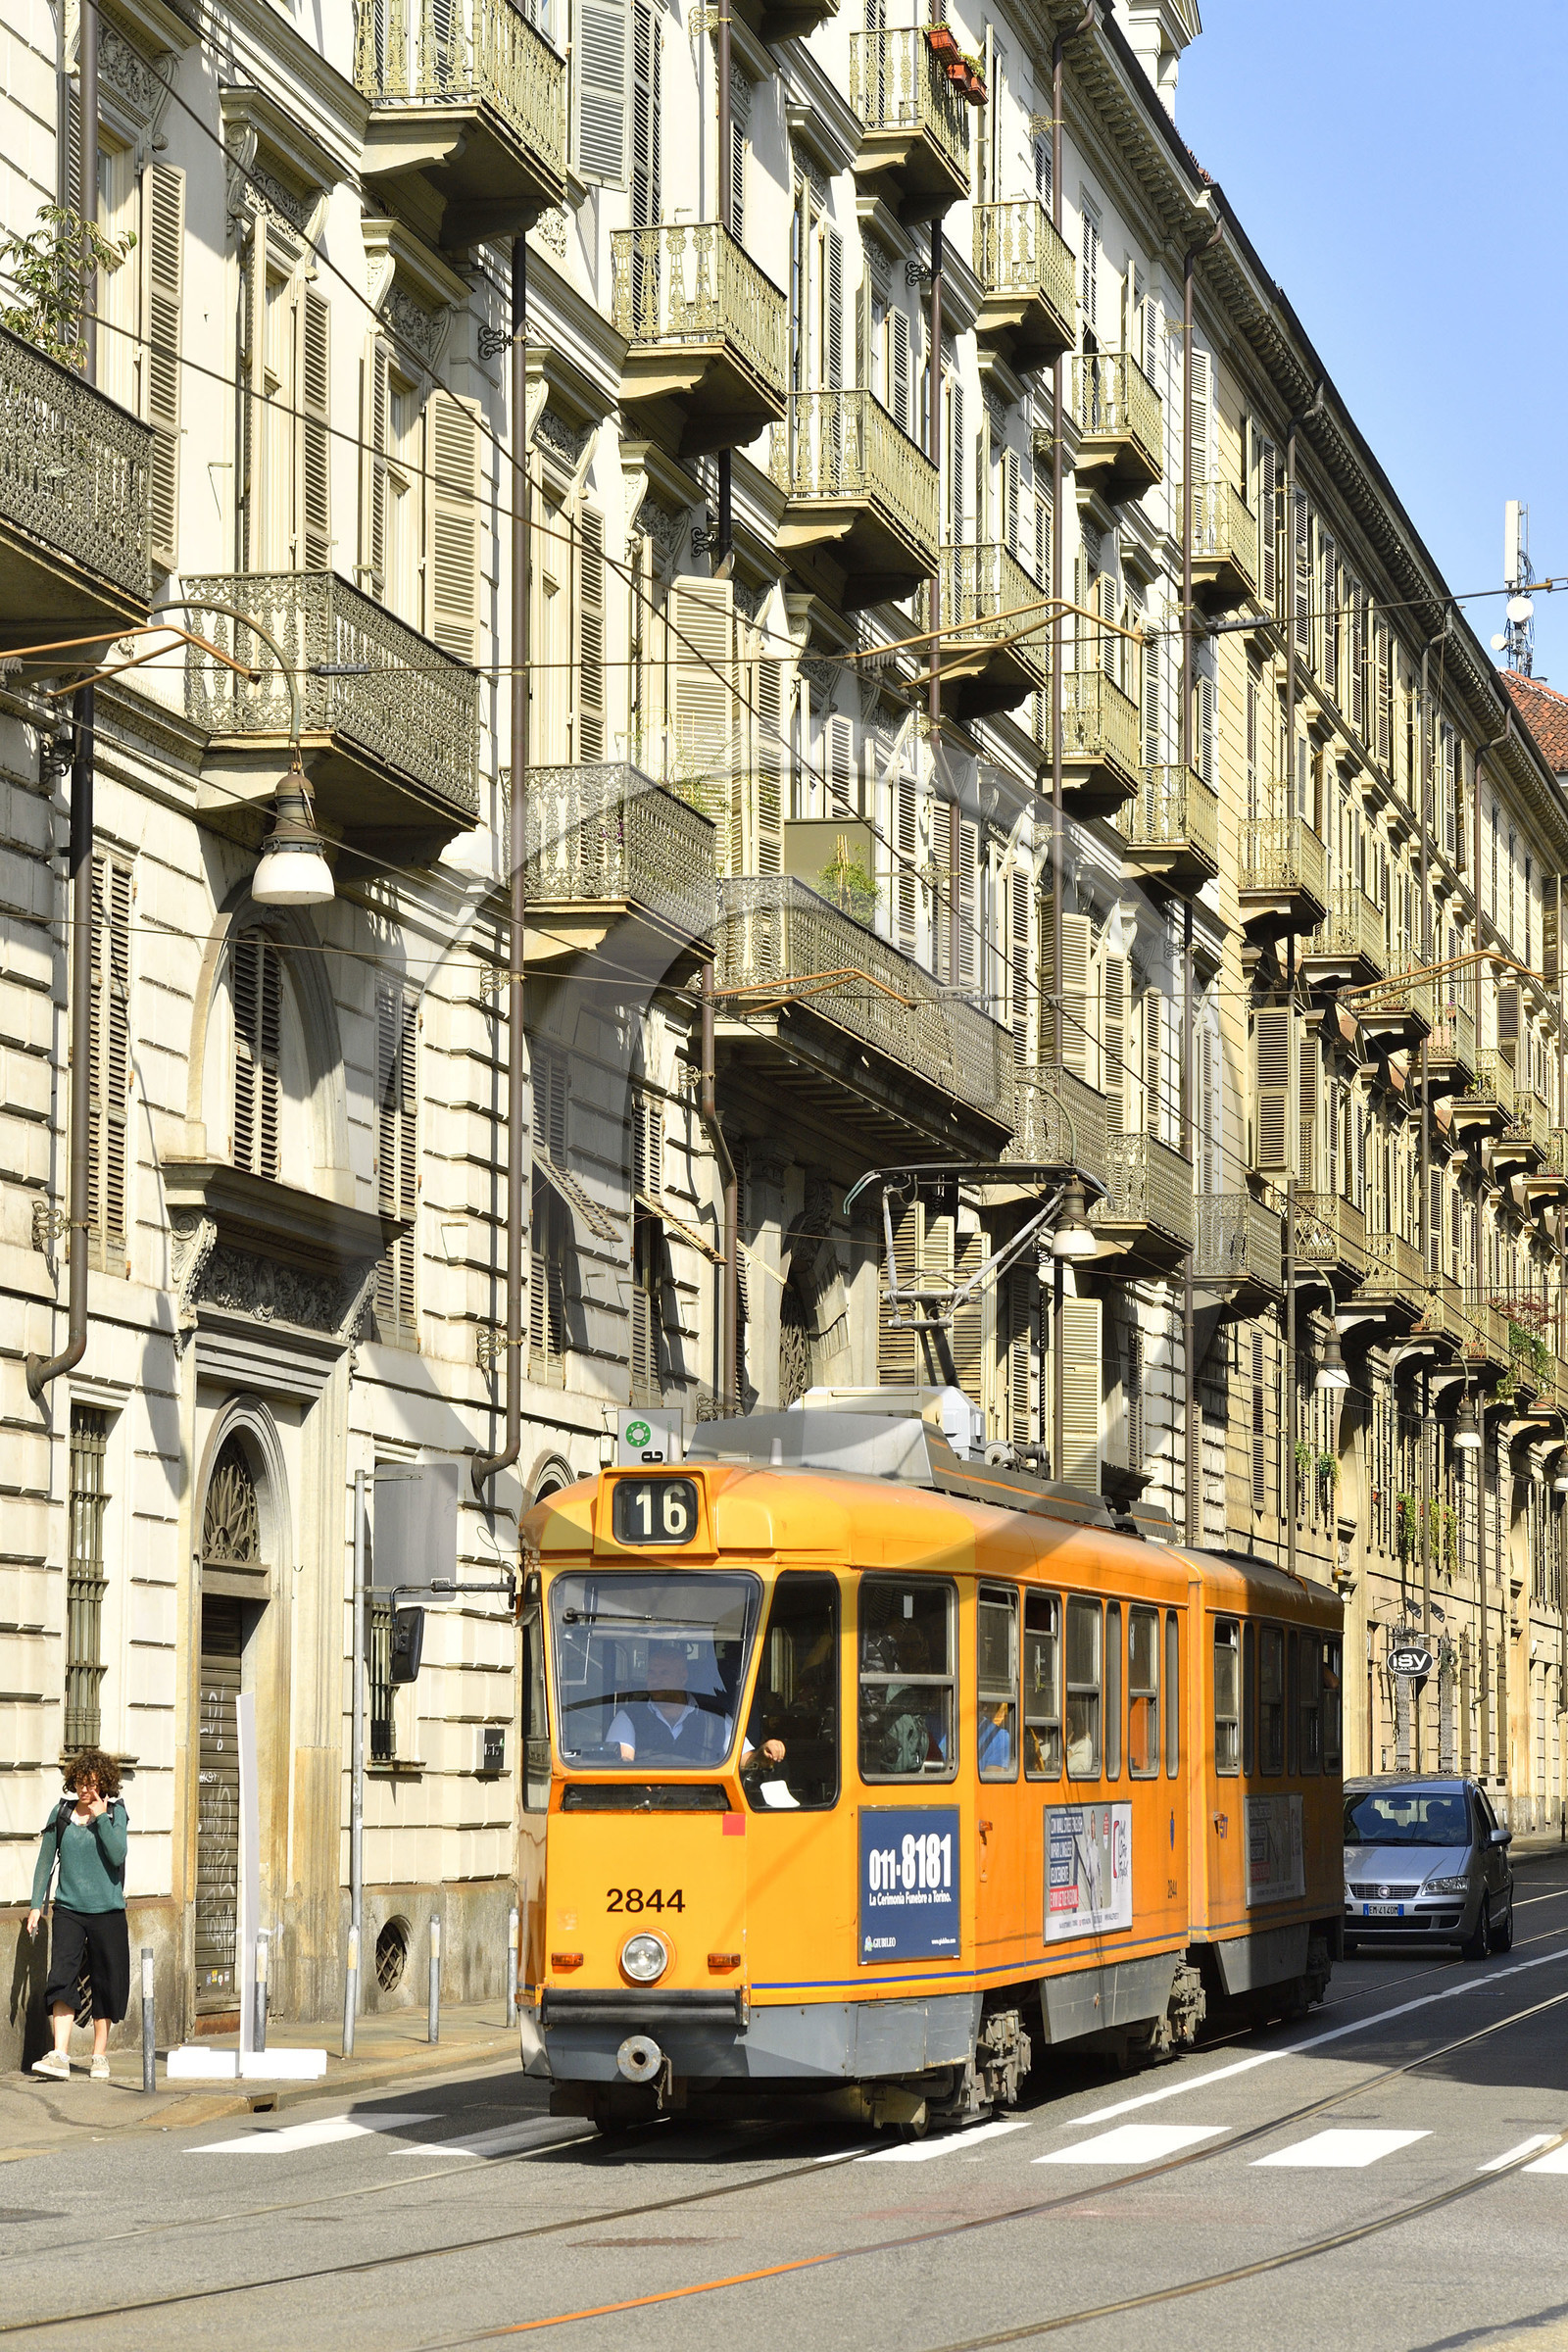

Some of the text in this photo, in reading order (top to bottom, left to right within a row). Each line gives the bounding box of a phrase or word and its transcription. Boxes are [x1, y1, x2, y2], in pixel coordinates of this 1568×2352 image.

[636, 1485, 687, 1535] 16
[869, 1834, 952, 1890] 011-8181
[606, 1887, 686, 1913] 2844
[869, 1893, 877, 1906] La
[877, 1891, 905, 1906] Cerimonia
[906, 1890, 928, 1904] Funebre
[928, 1894, 933, 1904] a
